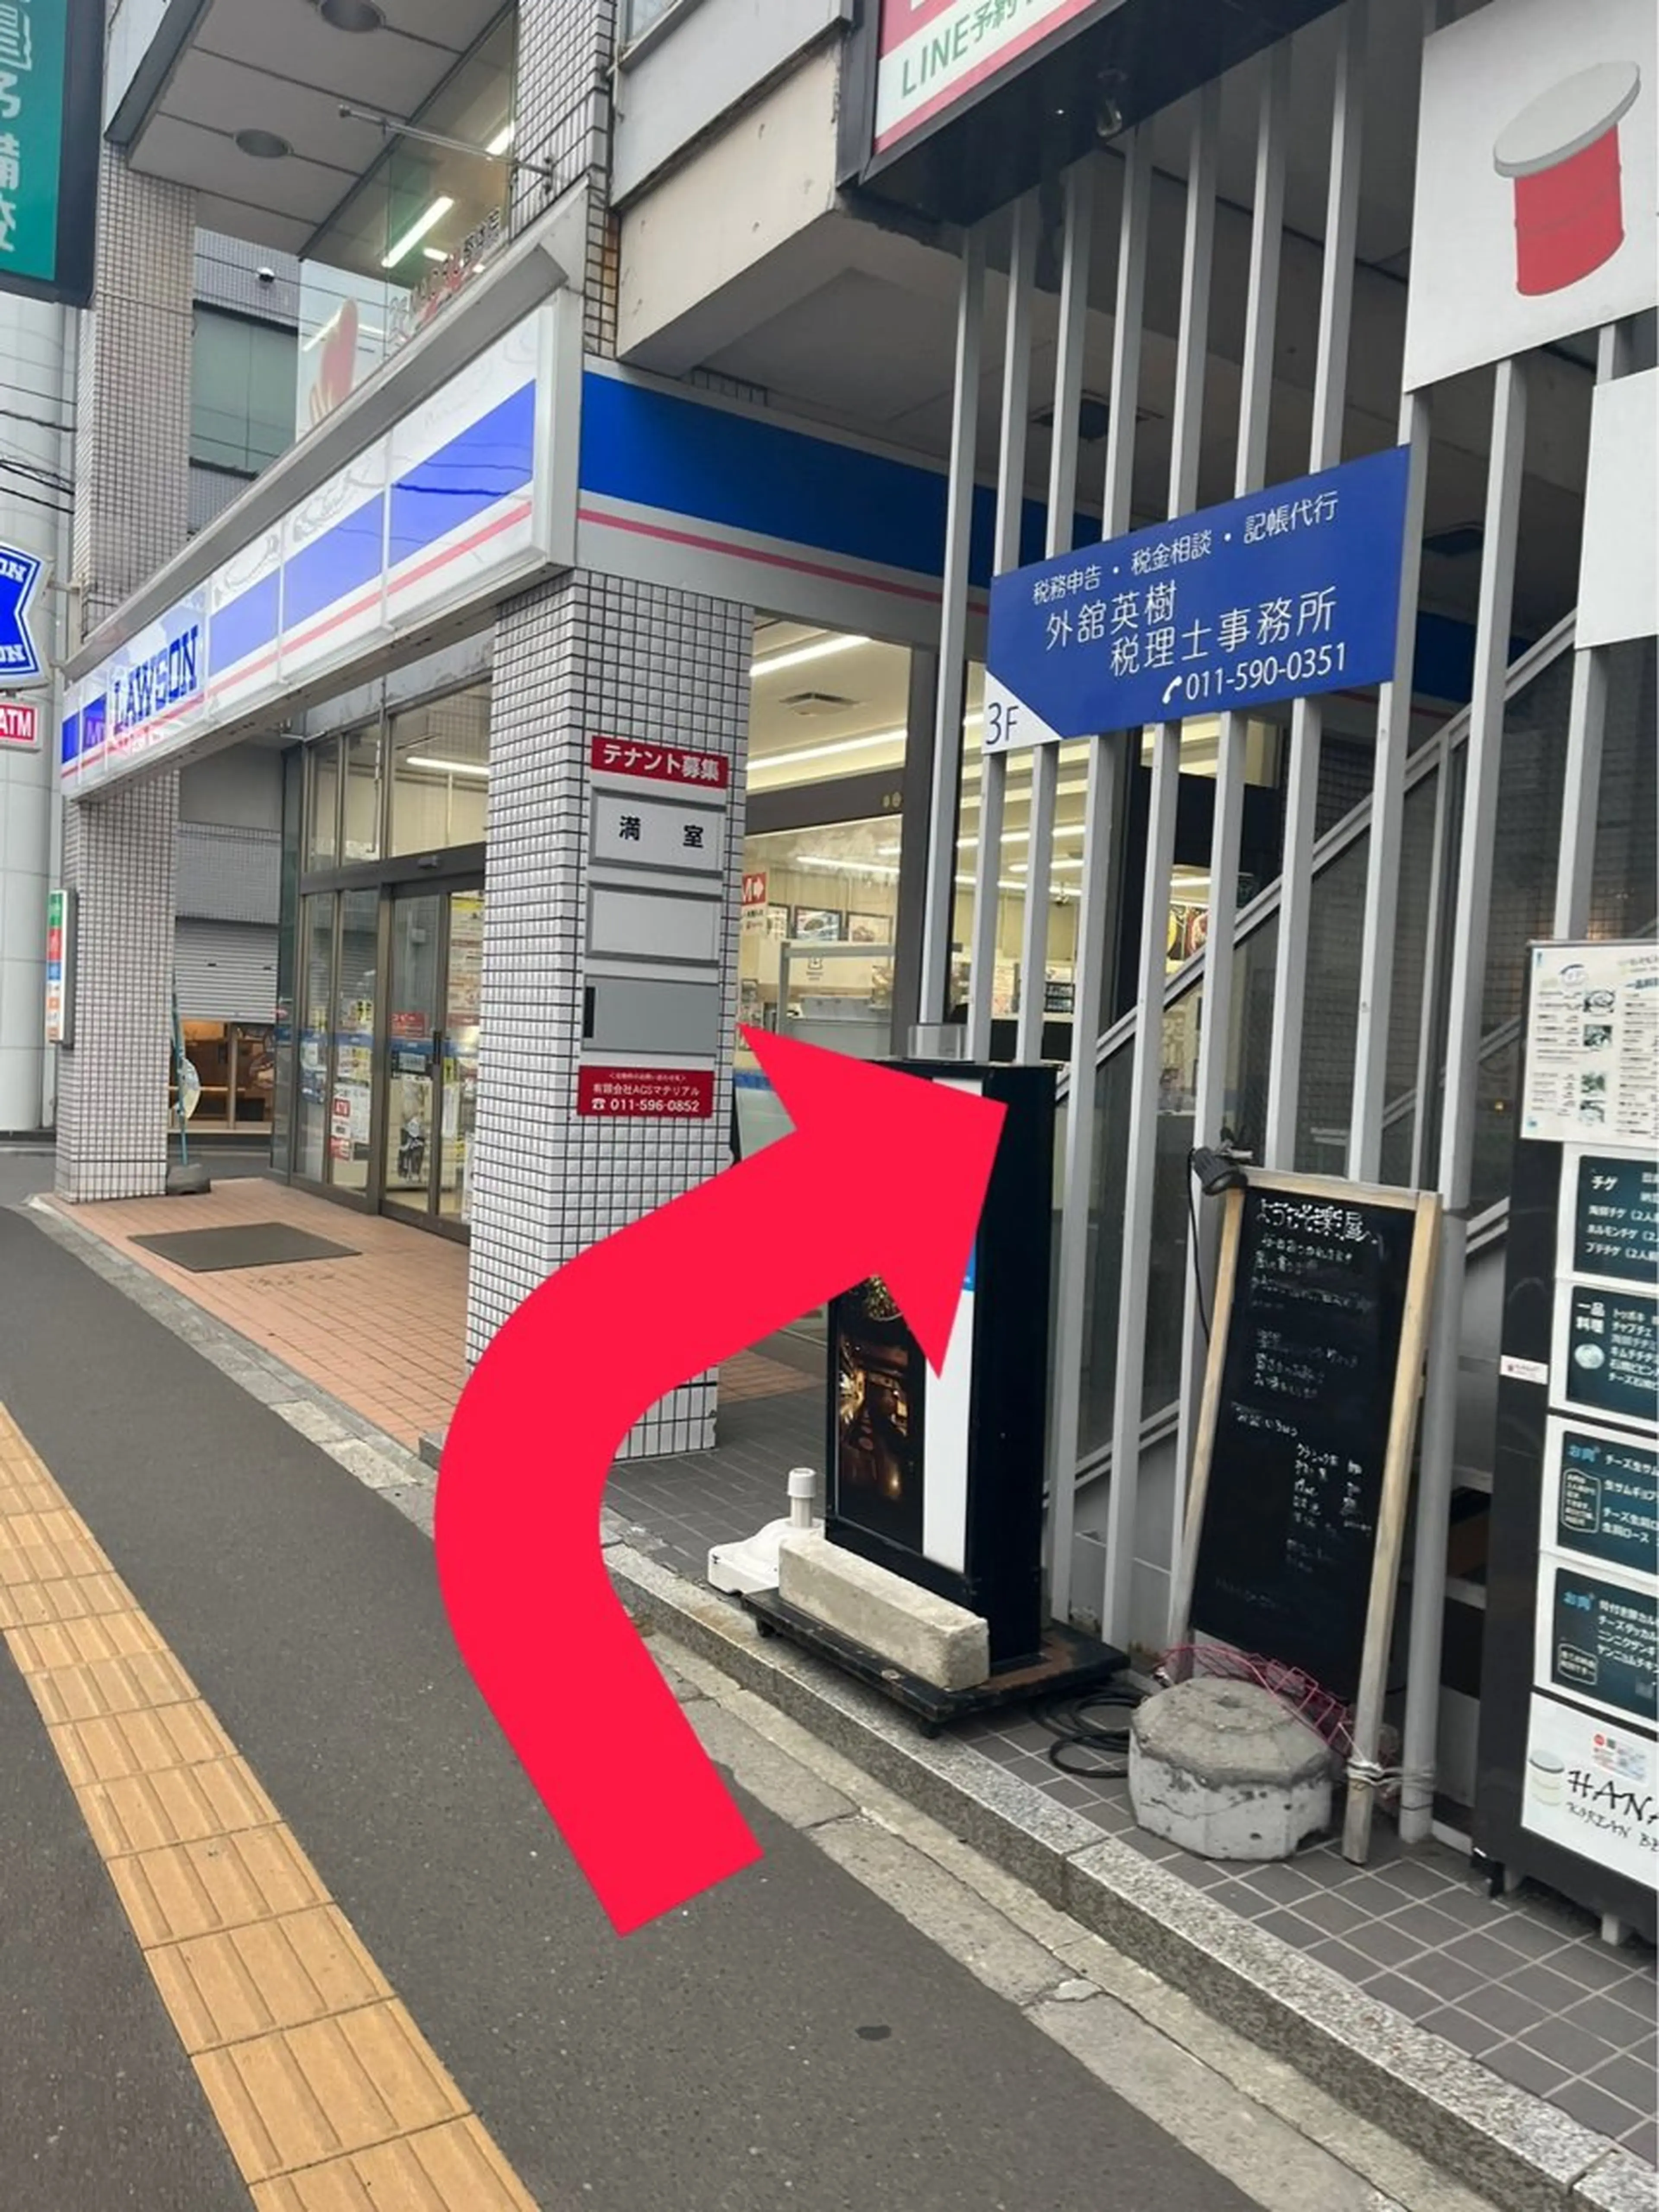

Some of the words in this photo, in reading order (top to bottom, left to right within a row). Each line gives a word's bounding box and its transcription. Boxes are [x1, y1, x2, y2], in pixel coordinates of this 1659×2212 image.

[1109, 586, 1338, 677] 税理士事務所
[1185, 642, 1345, 701] 011-590-0351
[985, 702, 1020, 745] 3F
[603, 744, 720, 782] テナント募集
[1567, 1770, 1657, 1825] HAN
